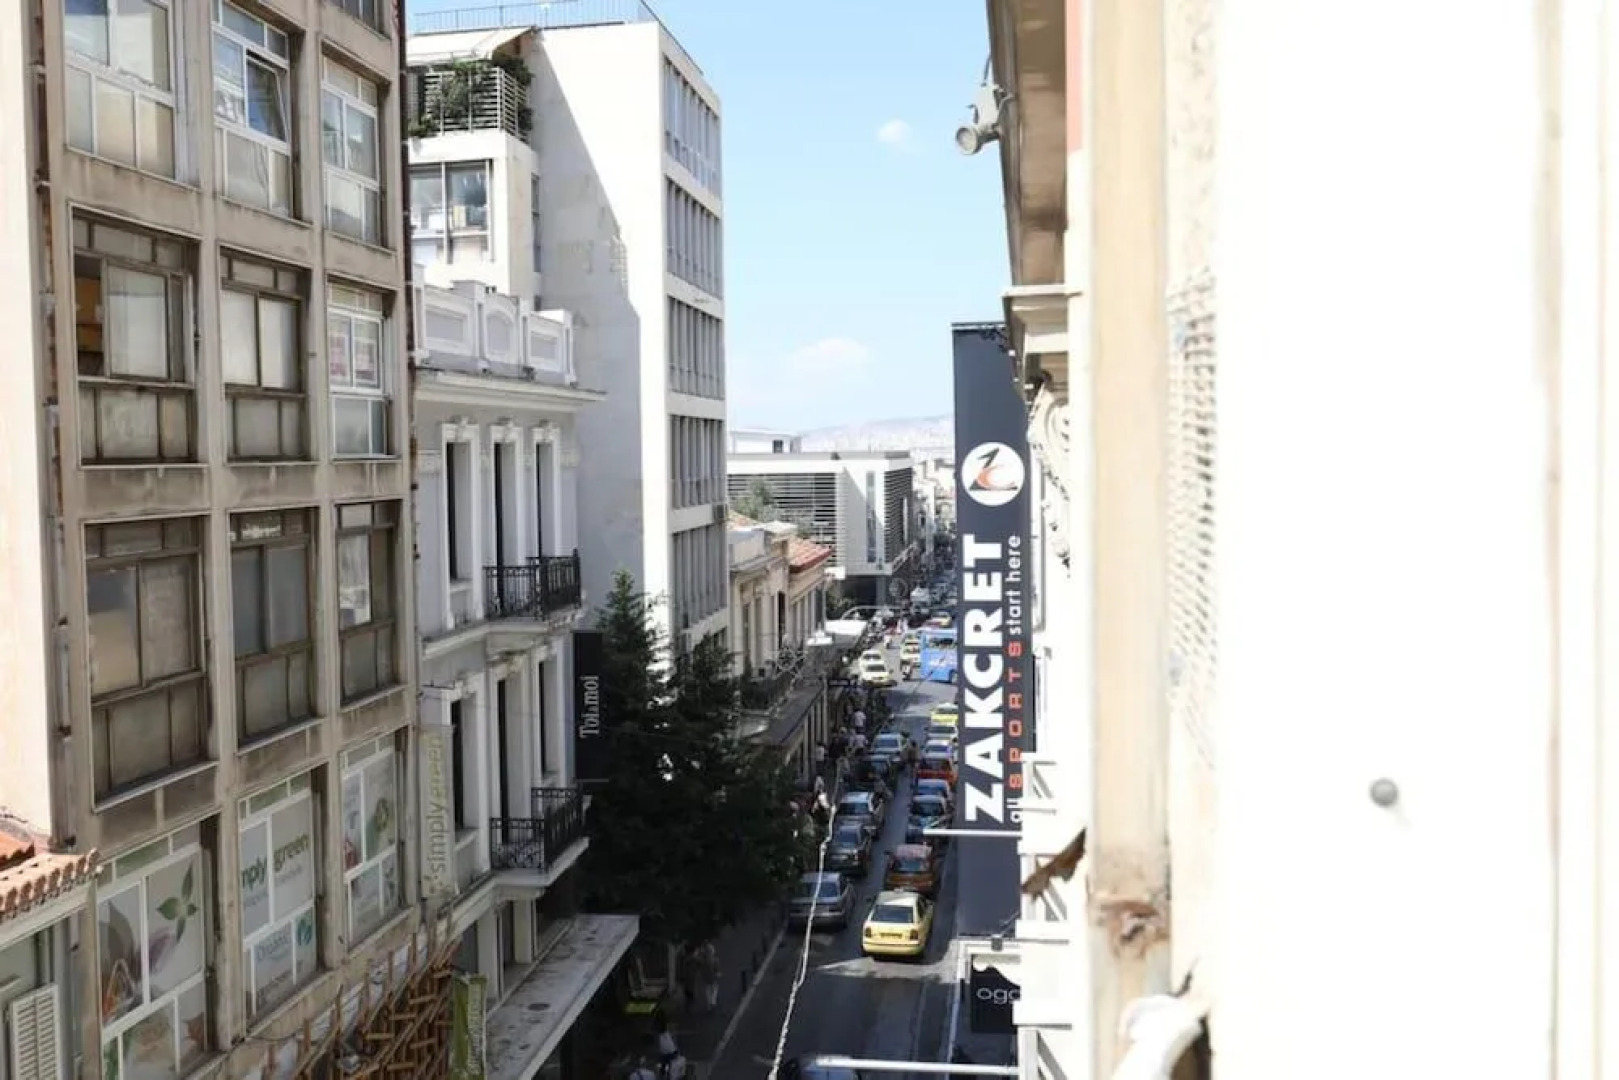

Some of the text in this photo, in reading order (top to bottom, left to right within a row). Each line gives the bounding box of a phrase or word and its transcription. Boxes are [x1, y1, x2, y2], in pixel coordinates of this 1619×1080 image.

[1005, 535, 1021, 582] here
[1005, 590, 1022, 635] start
[963, 534, 1004, 823] ZAKCRET
[1007, 641, 1023, 788] SPORTS
[273, 832, 309, 873] green
[426, 802, 448, 873] simply
